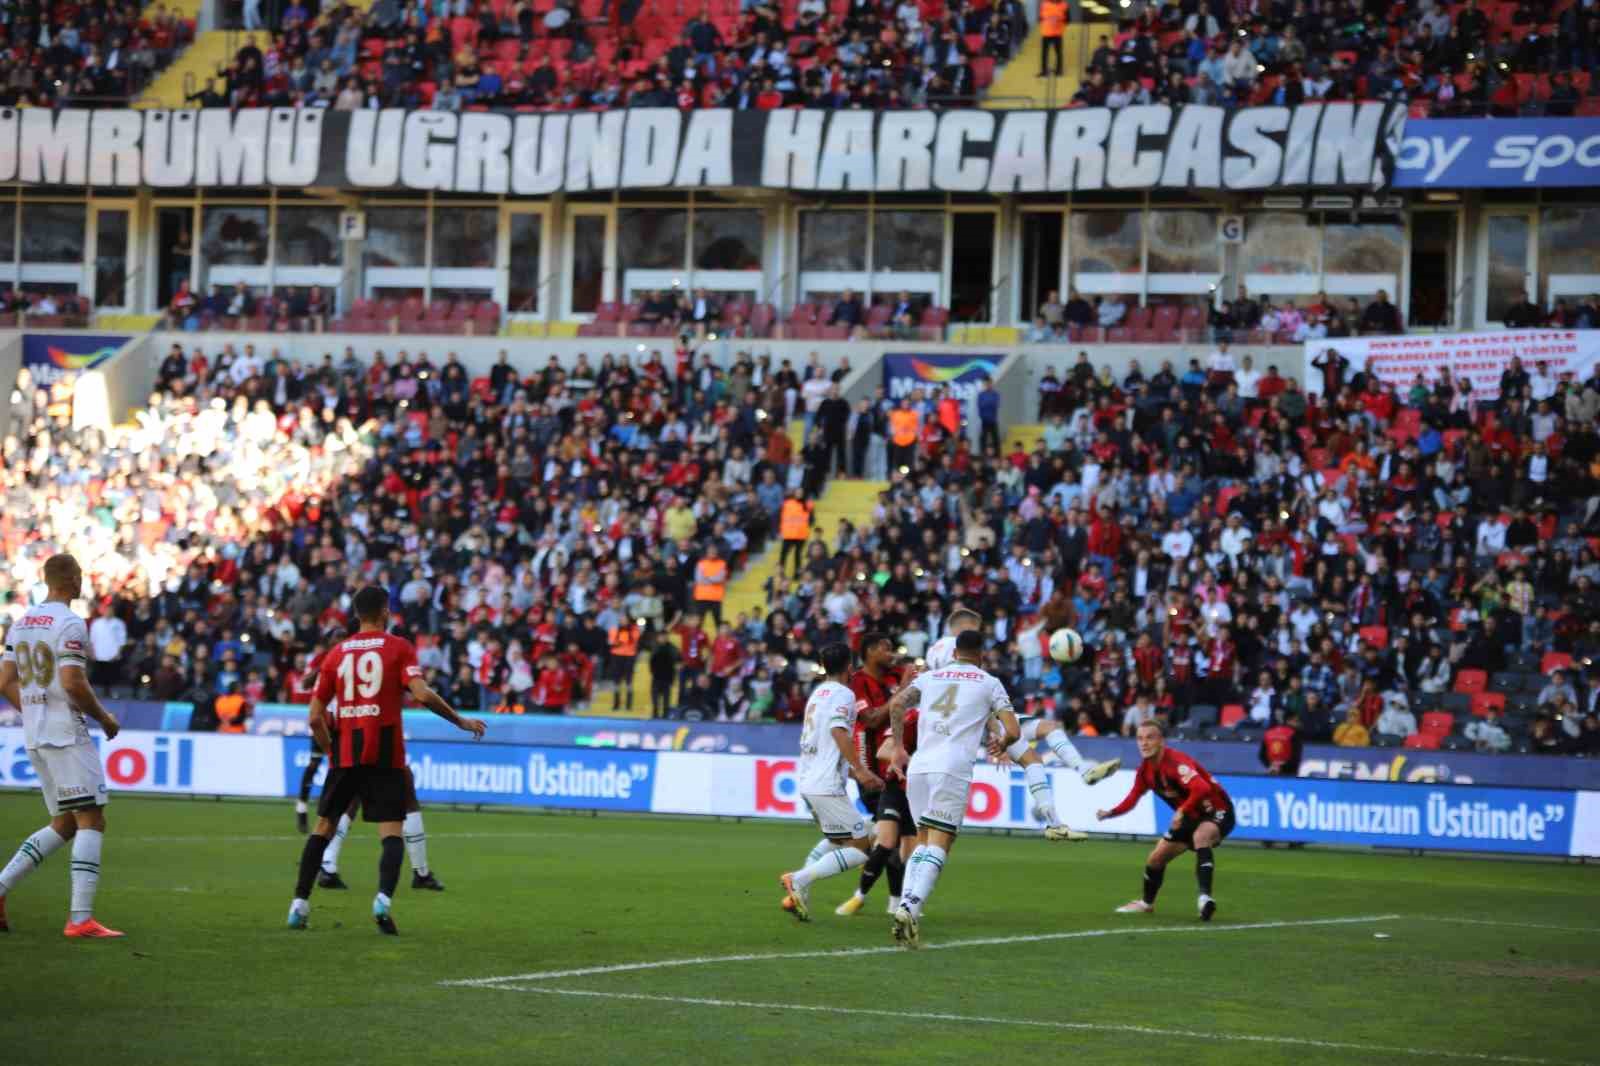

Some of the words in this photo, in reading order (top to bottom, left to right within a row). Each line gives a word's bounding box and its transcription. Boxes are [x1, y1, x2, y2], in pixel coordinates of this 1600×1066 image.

[346, 107, 733, 194] UĞRUNDA
[1223, 219, 1240, 240] G
[337, 651, 384, 702] 19
[930, 683, 959, 719] 4
[1275, 790, 1421, 836] Yolunuzun
